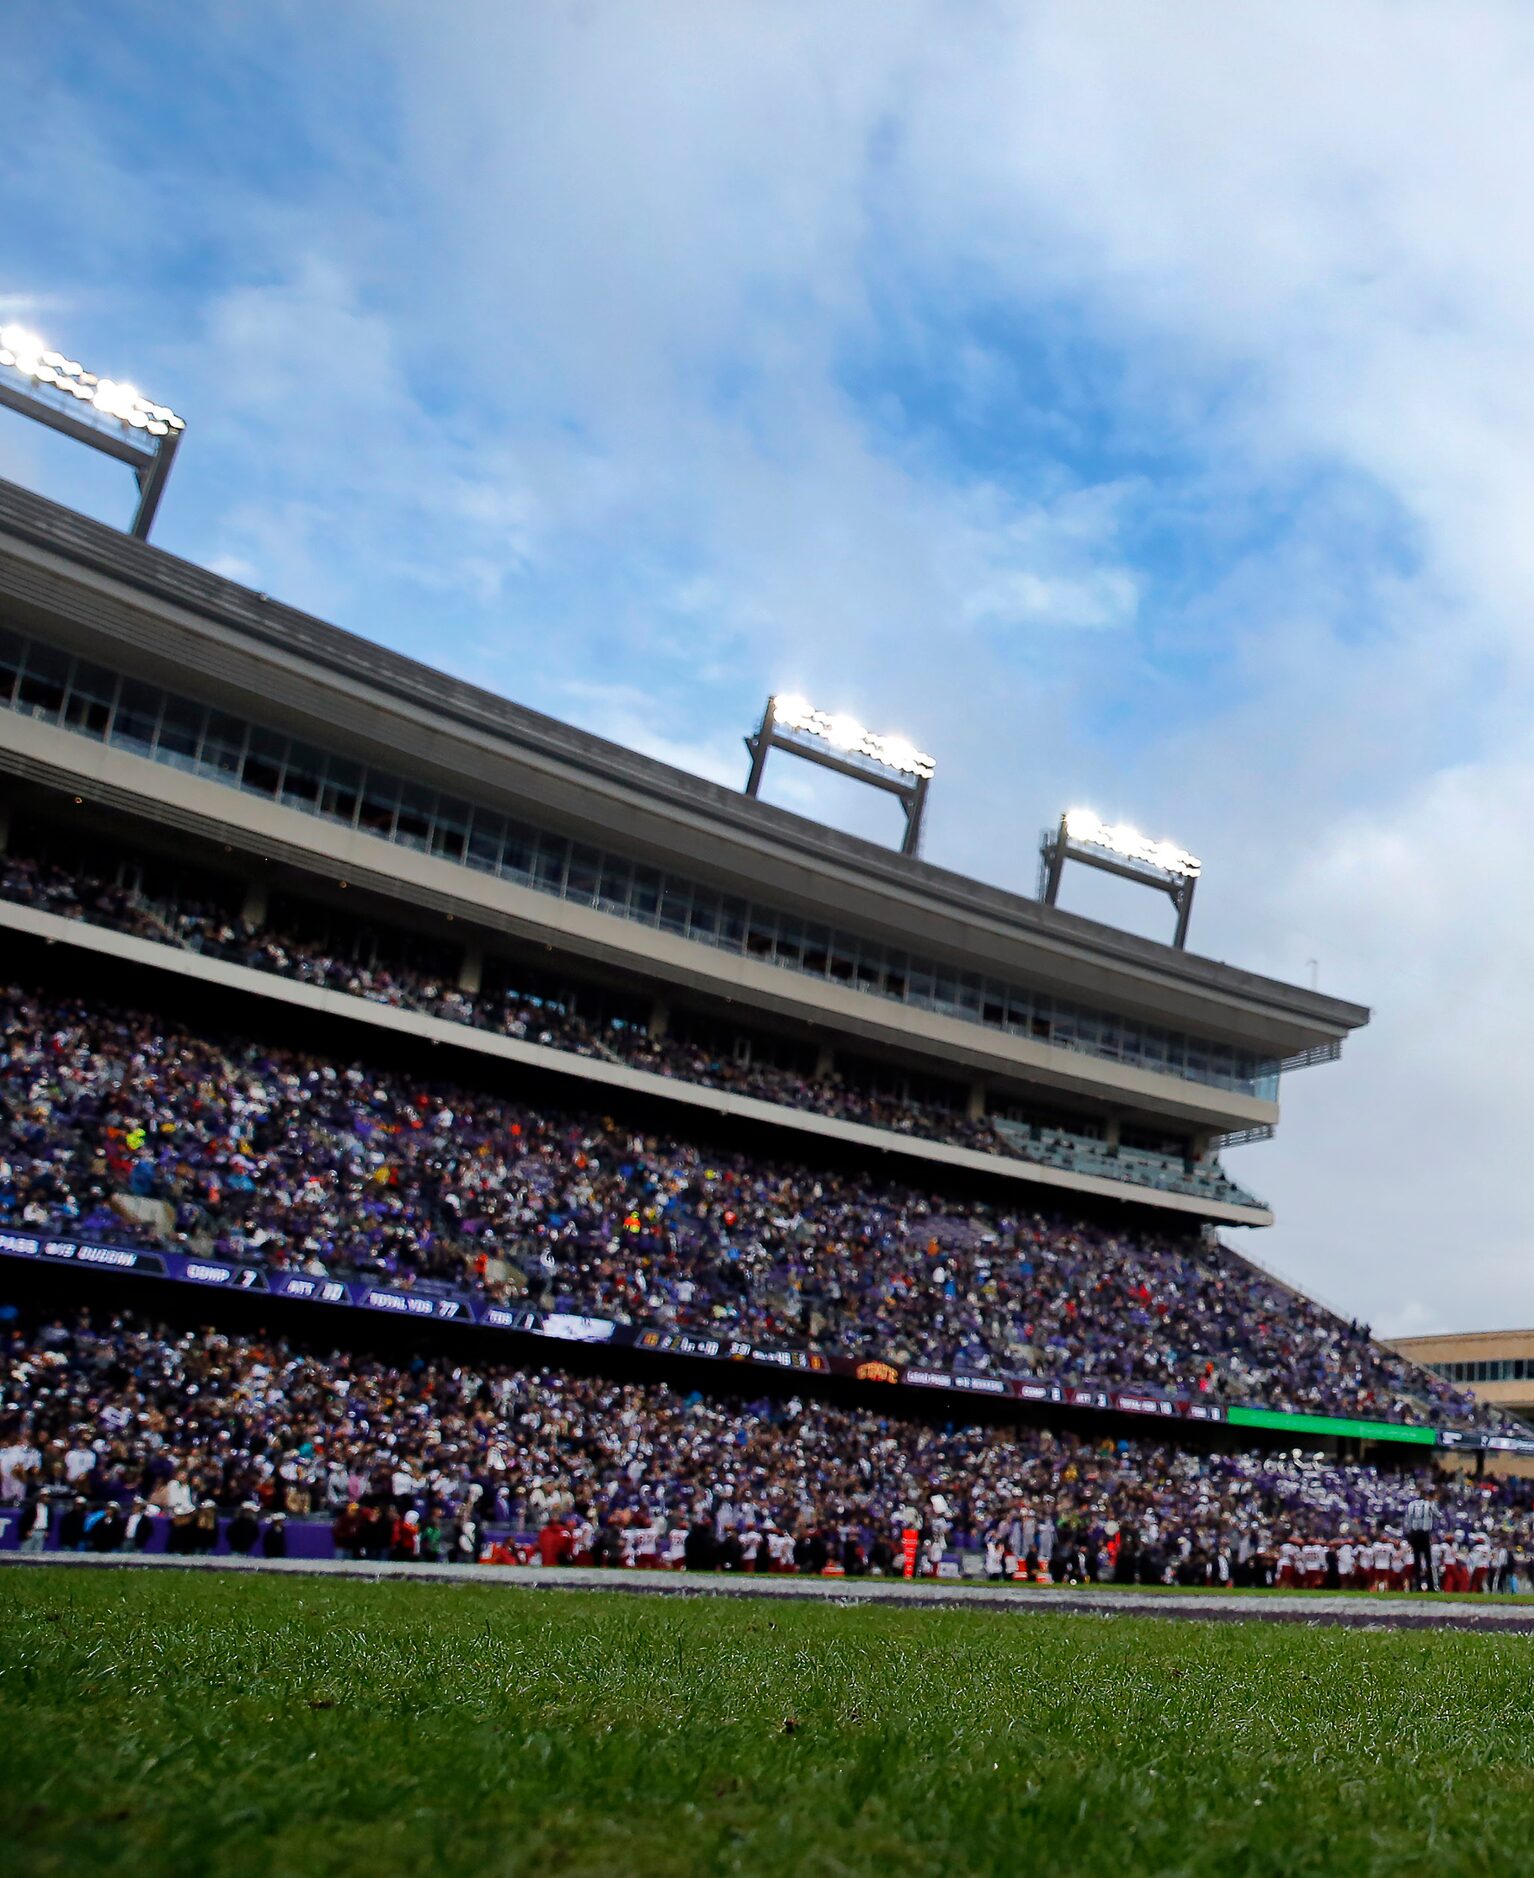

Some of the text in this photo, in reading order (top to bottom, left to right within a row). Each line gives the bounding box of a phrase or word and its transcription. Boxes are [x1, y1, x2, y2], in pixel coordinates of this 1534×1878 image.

[241, 1269, 257, 1288] 7
[369, 1292, 460, 1318] TOTAL YDS 77
